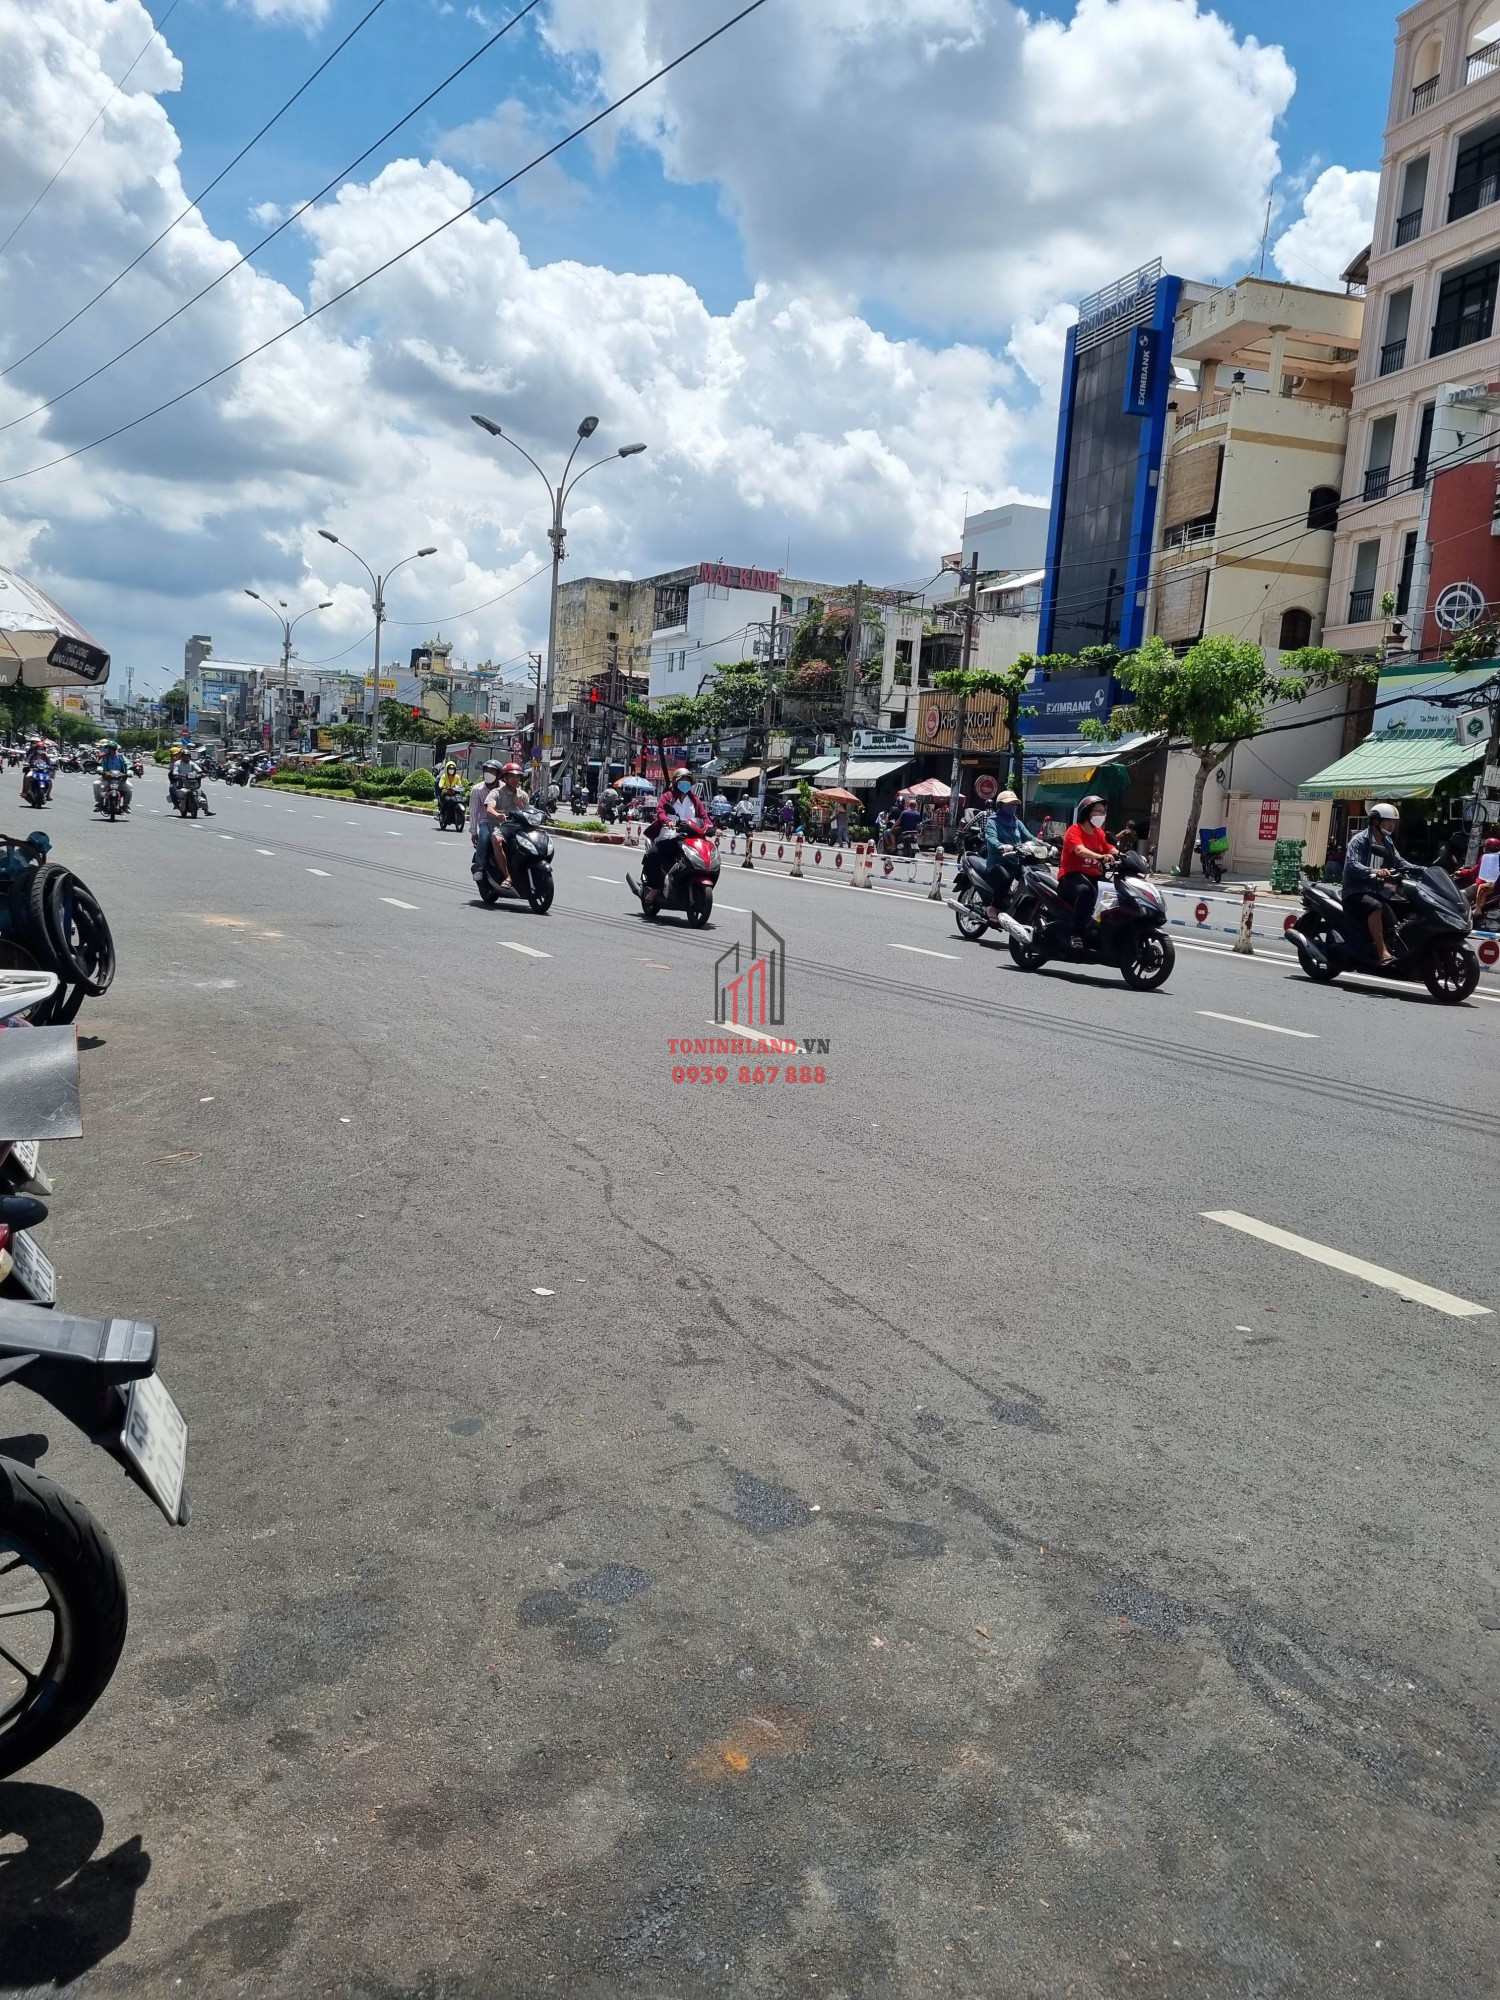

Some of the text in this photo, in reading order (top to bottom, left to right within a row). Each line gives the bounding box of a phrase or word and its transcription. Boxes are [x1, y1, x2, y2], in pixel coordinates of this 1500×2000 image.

[1079, 294, 1137, 335] EXIMBANK
[1138, 350, 1151, 406] EXIMBANK
[739, 564, 778, 592] KÍNH
[1046, 701, 1092, 713] EXIMBANK
[155, 1399, 184, 1511] 021.58
